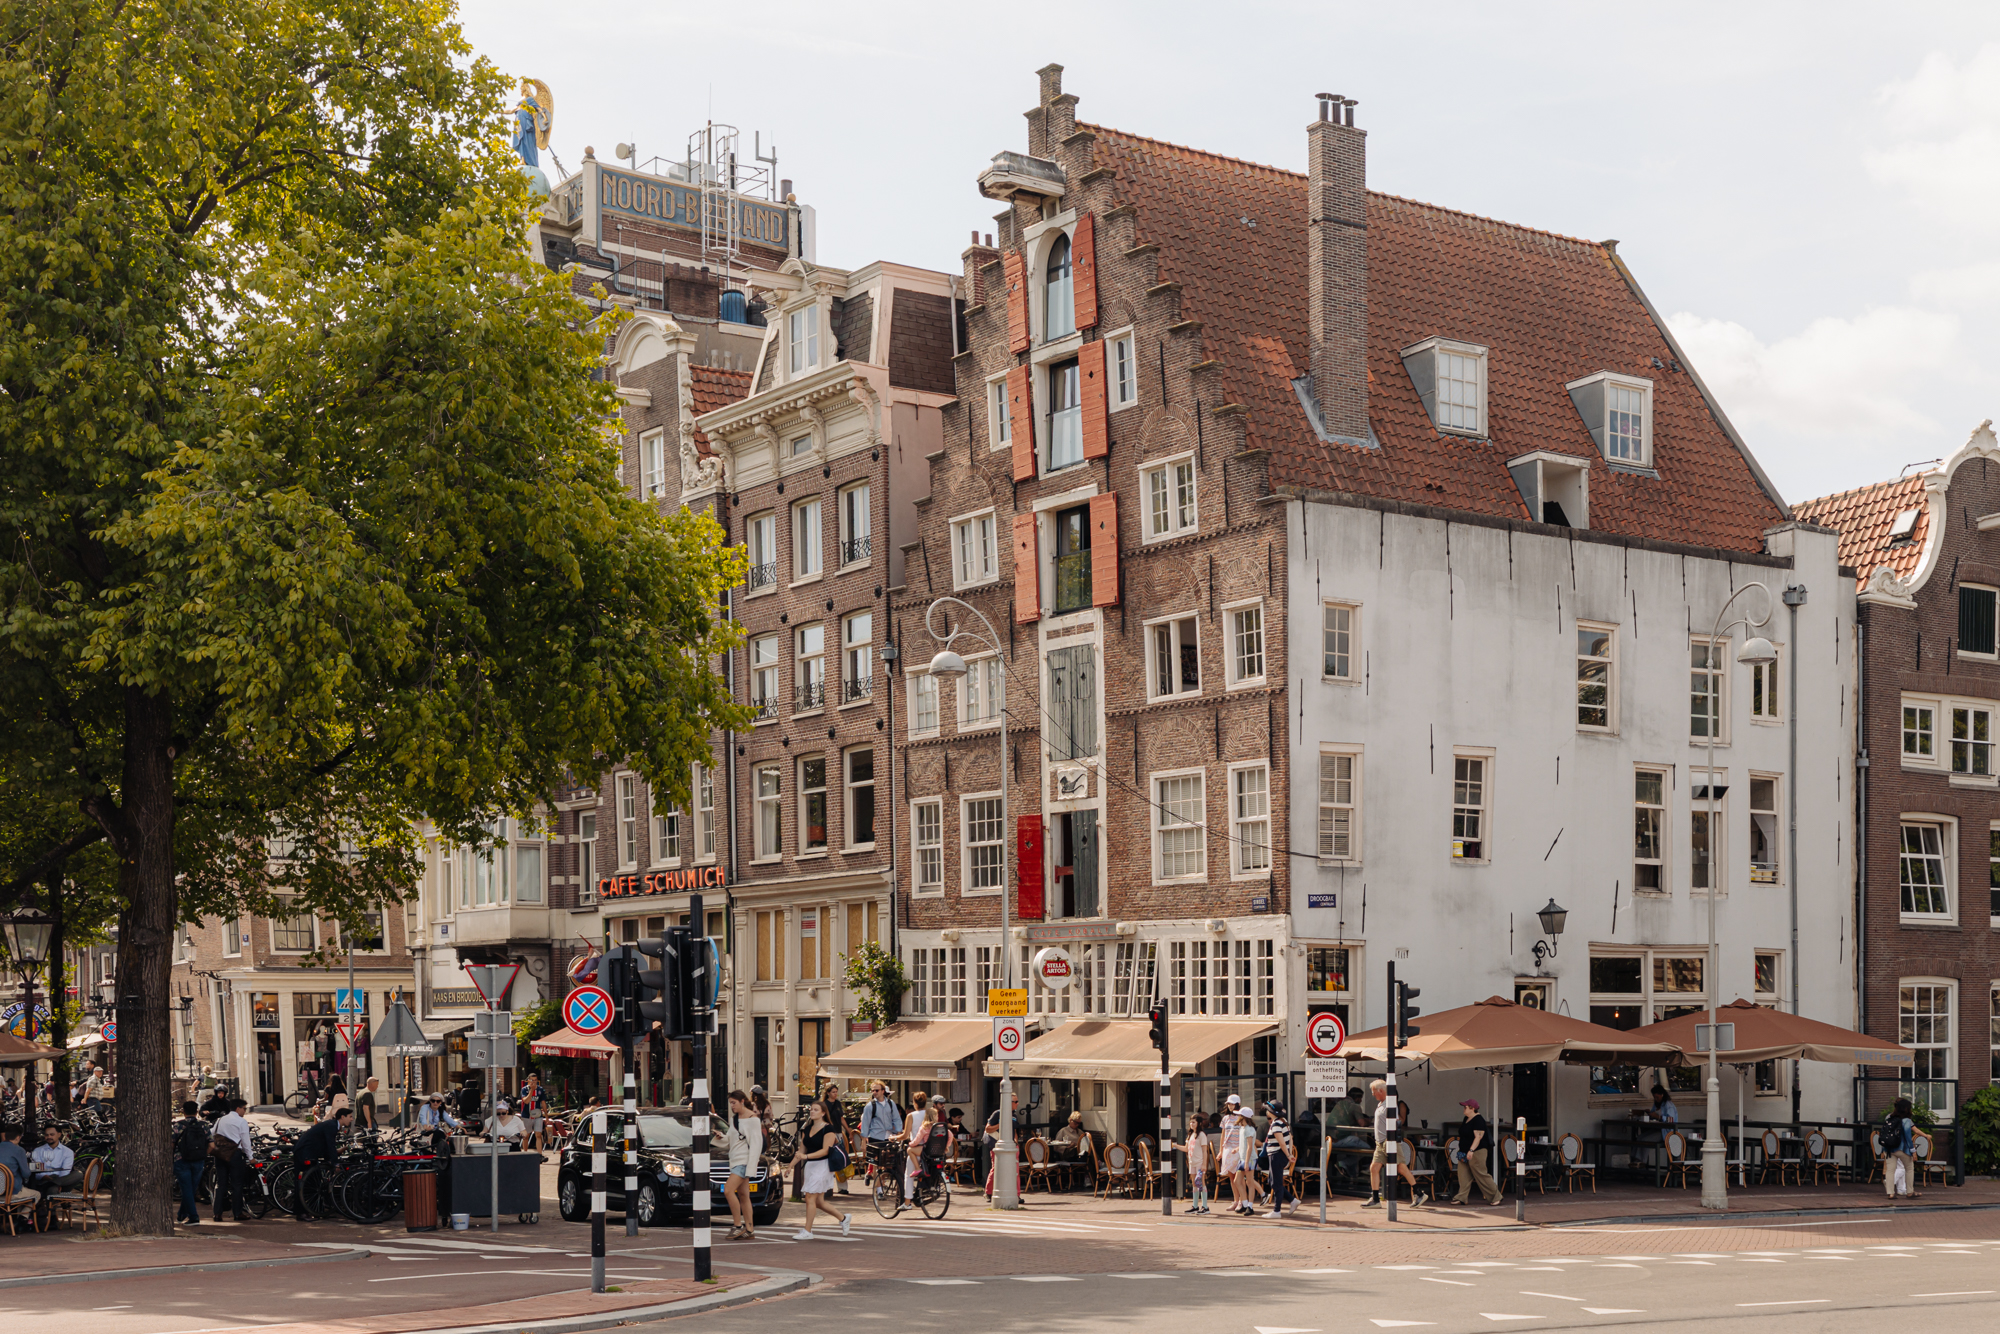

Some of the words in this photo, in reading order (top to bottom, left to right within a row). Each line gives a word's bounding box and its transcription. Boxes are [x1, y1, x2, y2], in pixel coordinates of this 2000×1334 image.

[602, 173, 783, 243] NOORD-BRABAND
[599, 876, 637, 896] CAFE
[645, 866, 725, 893] SCHUMICH
[1033, 929, 1060, 937] CAFE
[1068, 926, 1109, 935] KOBALT
[434, 992, 447, 1003] KAAS
[449, 992, 456, 1003] EN
[3, 1006, 16, 1019] THE
[256, 1013, 279, 1021] ZILCH
[1002, 1033, 1017, 1044] 30
[1854, 1050, 1883, 1061] VEDETT
